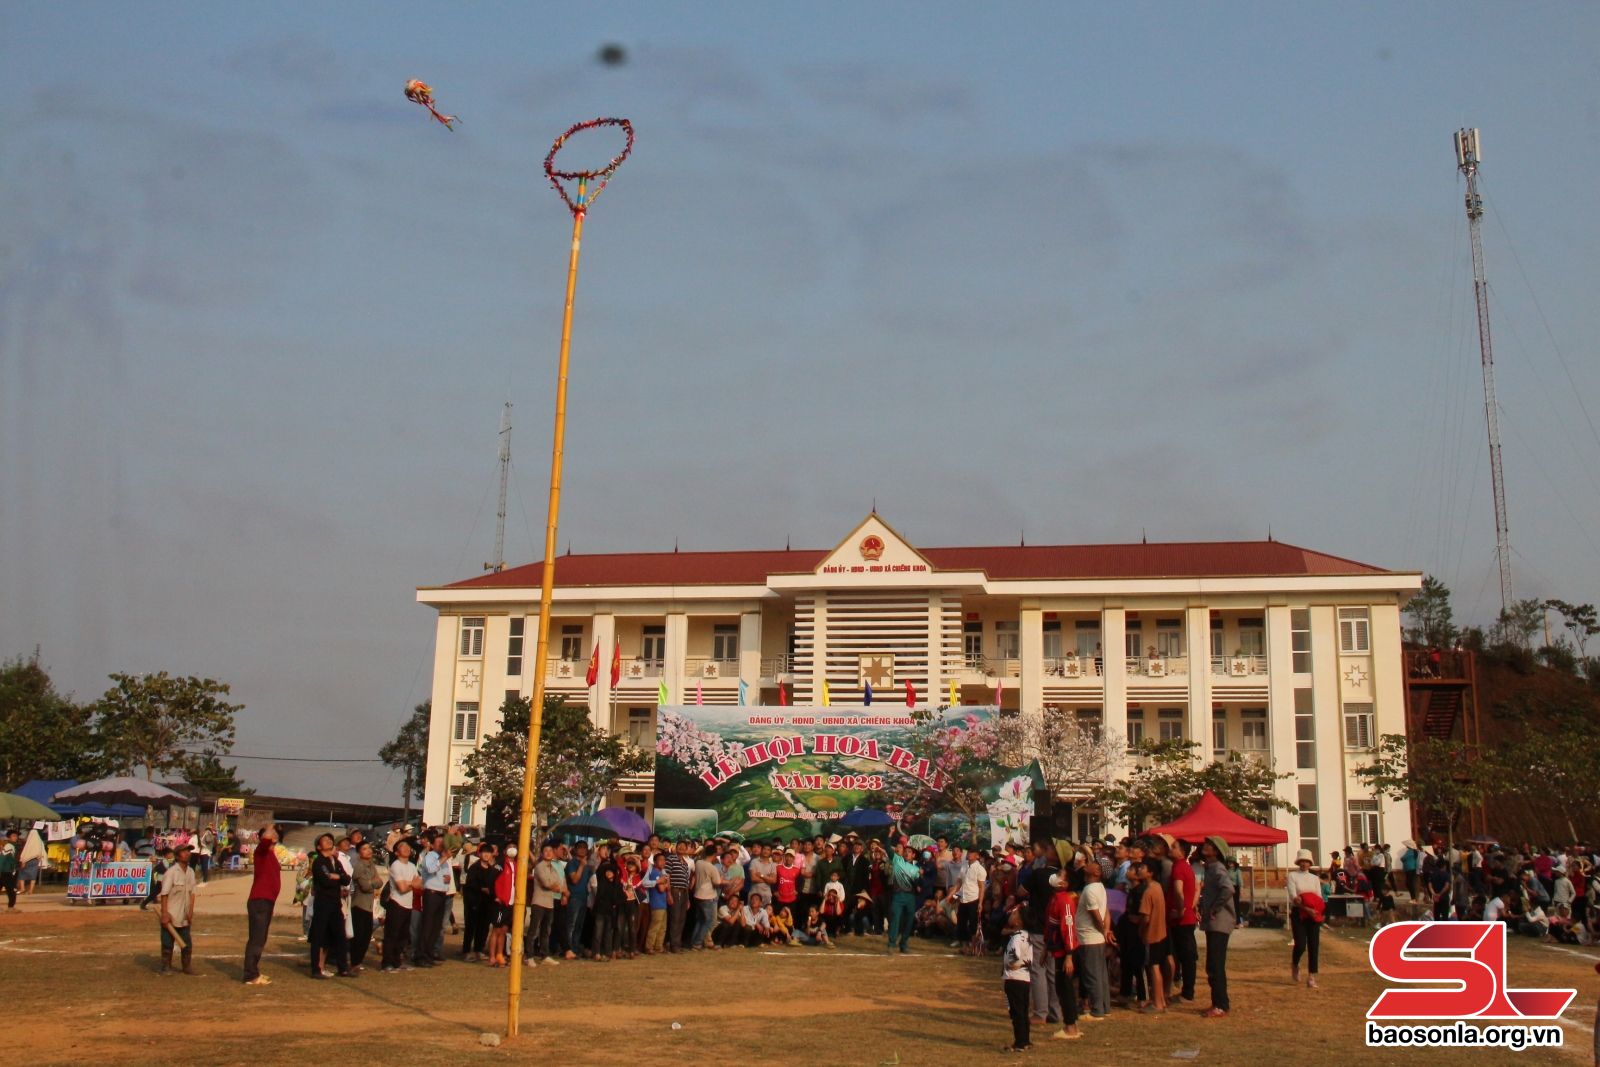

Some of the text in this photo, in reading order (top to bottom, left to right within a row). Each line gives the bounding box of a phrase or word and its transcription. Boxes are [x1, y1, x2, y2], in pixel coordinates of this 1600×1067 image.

[792, 716, 814, 725] HĐND
[822, 716, 845, 725] UBND
[892, 716, 915, 725] KHOA
[699, 734, 953, 792] LỄ HỘI HOA BAN
[772, 771, 884, 790] NĂM 2023
[95, 868, 115, 879] KEM
[105, 883, 134, 896] HÀ NỘI
